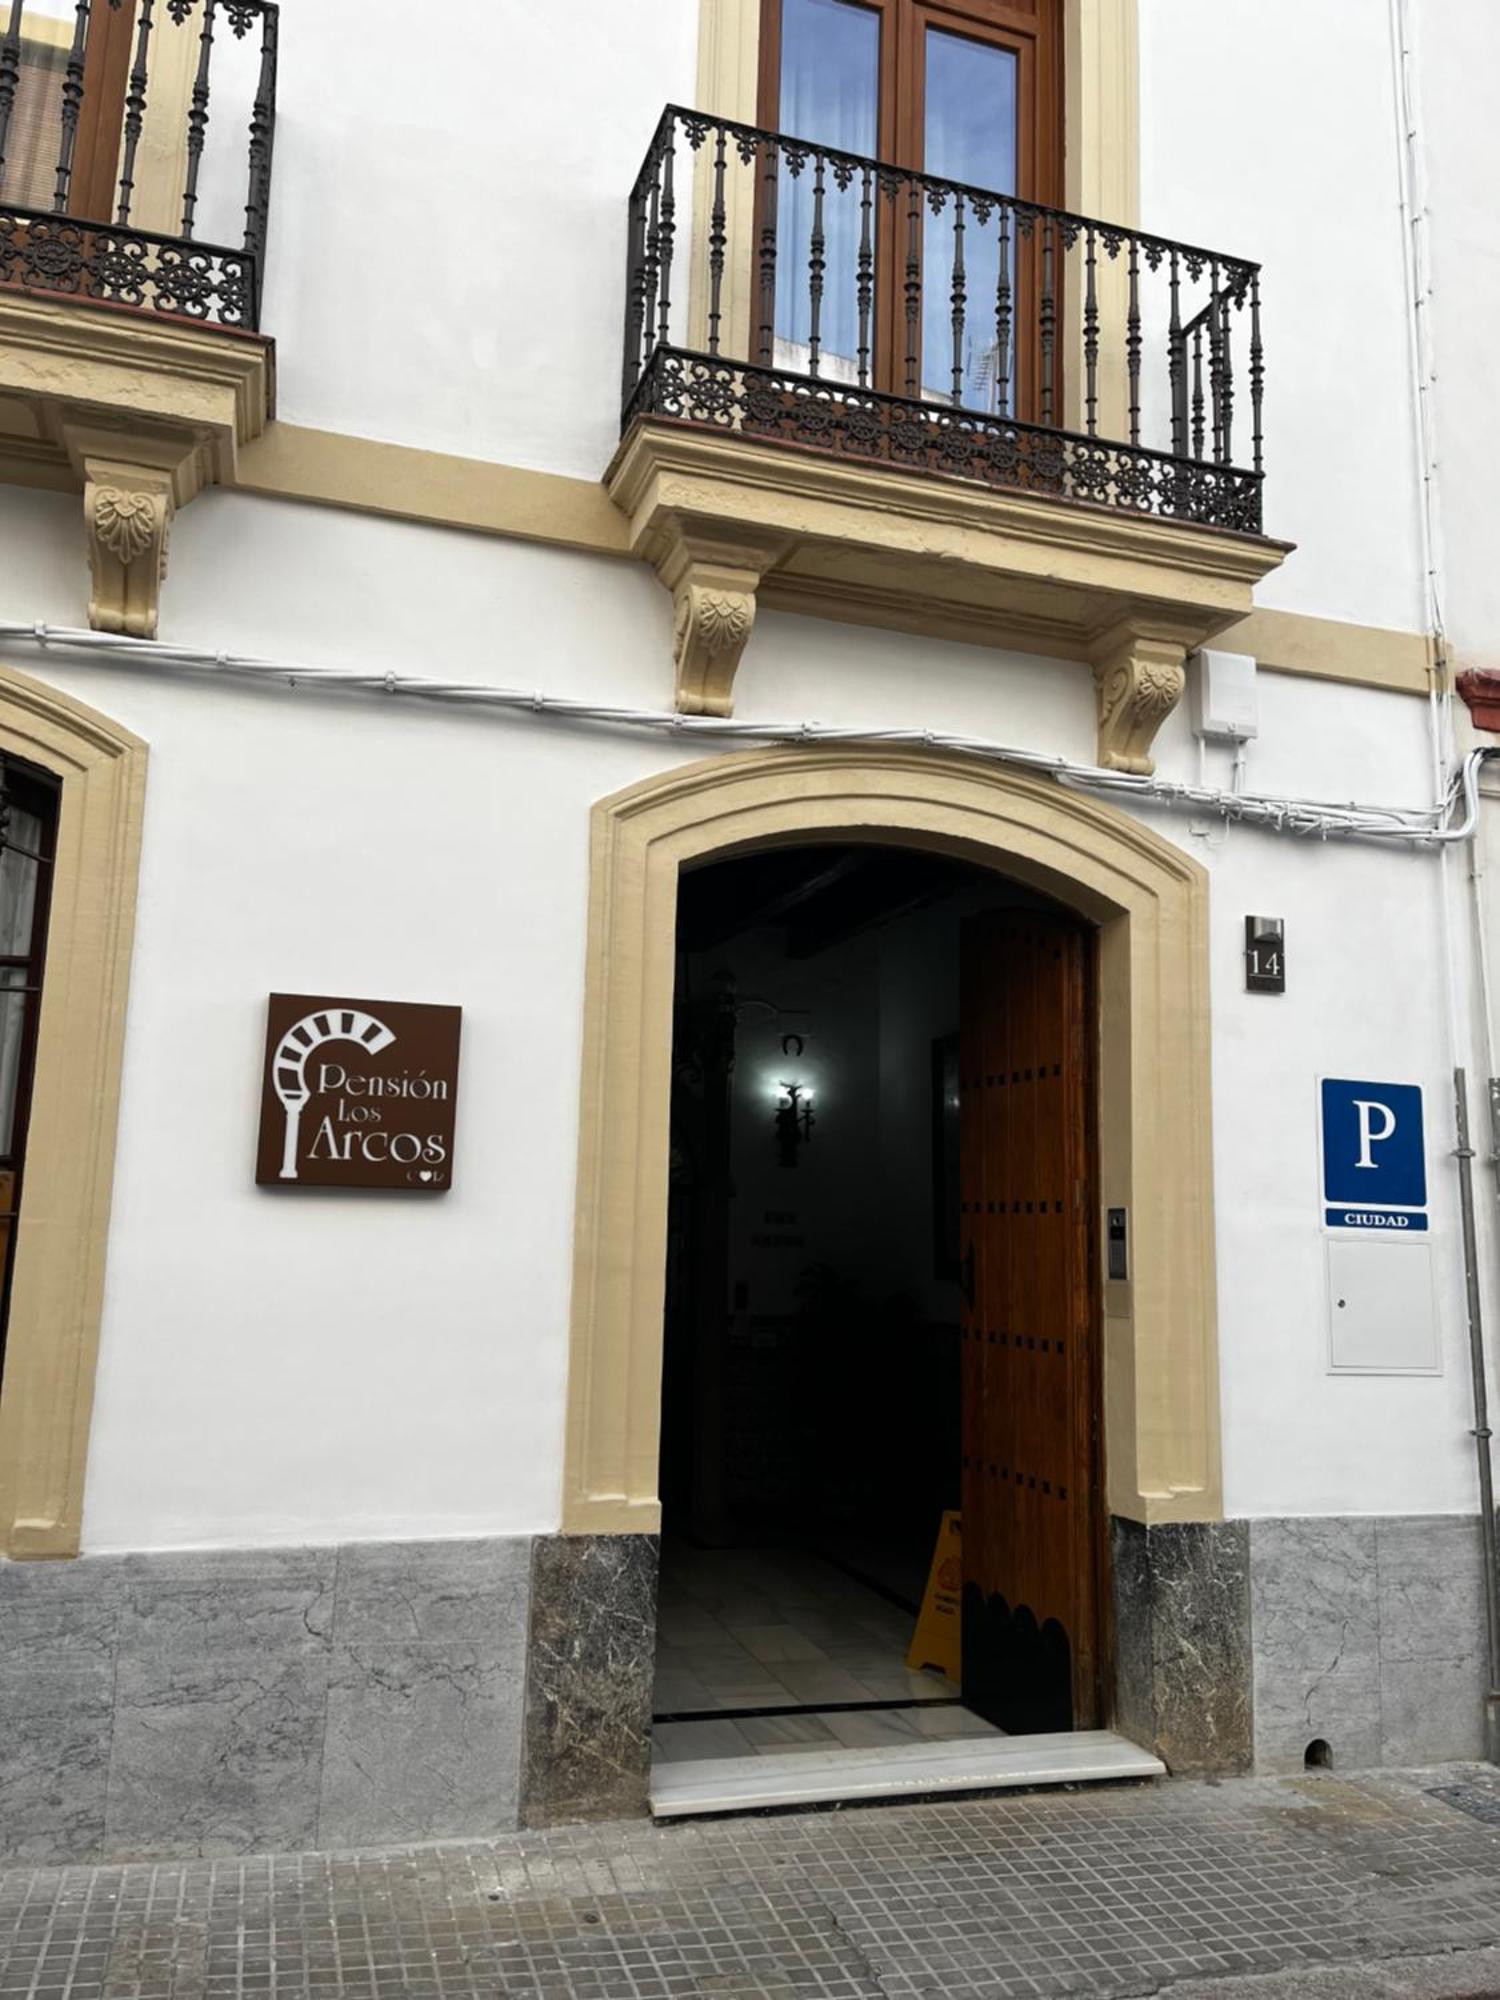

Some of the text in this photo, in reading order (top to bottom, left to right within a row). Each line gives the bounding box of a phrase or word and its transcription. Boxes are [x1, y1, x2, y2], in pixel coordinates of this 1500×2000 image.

[1247, 949, 1281, 976] 14
[316, 1063, 448, 1100] Pensión
[337, 1098, 382, 1122] Los
[306, 1115, 446, 1164] Arcos
[1352, 1099, 1396, 1168] P
[1344, 1212, 1409, 1228] CIUDAD
